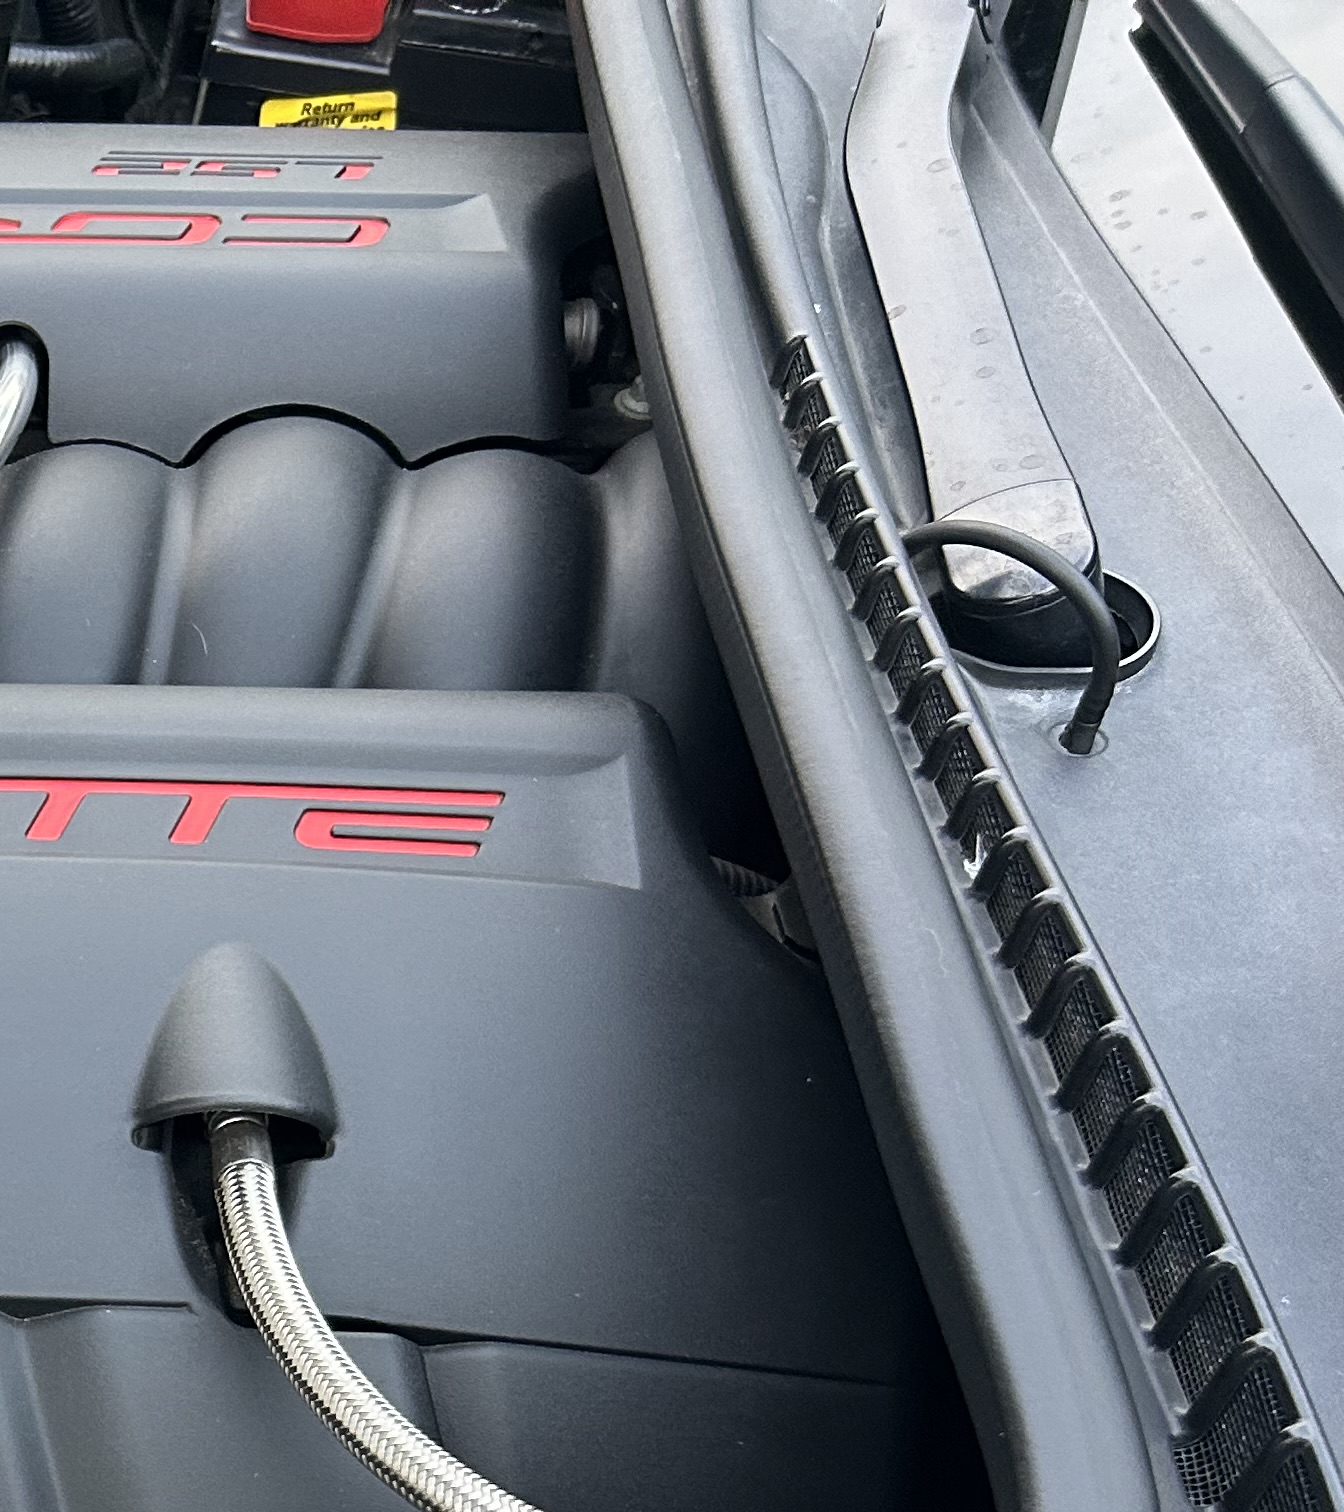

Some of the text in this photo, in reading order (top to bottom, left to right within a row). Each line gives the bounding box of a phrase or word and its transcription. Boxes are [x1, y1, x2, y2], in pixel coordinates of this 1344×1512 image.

[300, 101, 355, 116] Return
[350, 109, 382, 123] and
[90, 158, 377, 181] LS2
